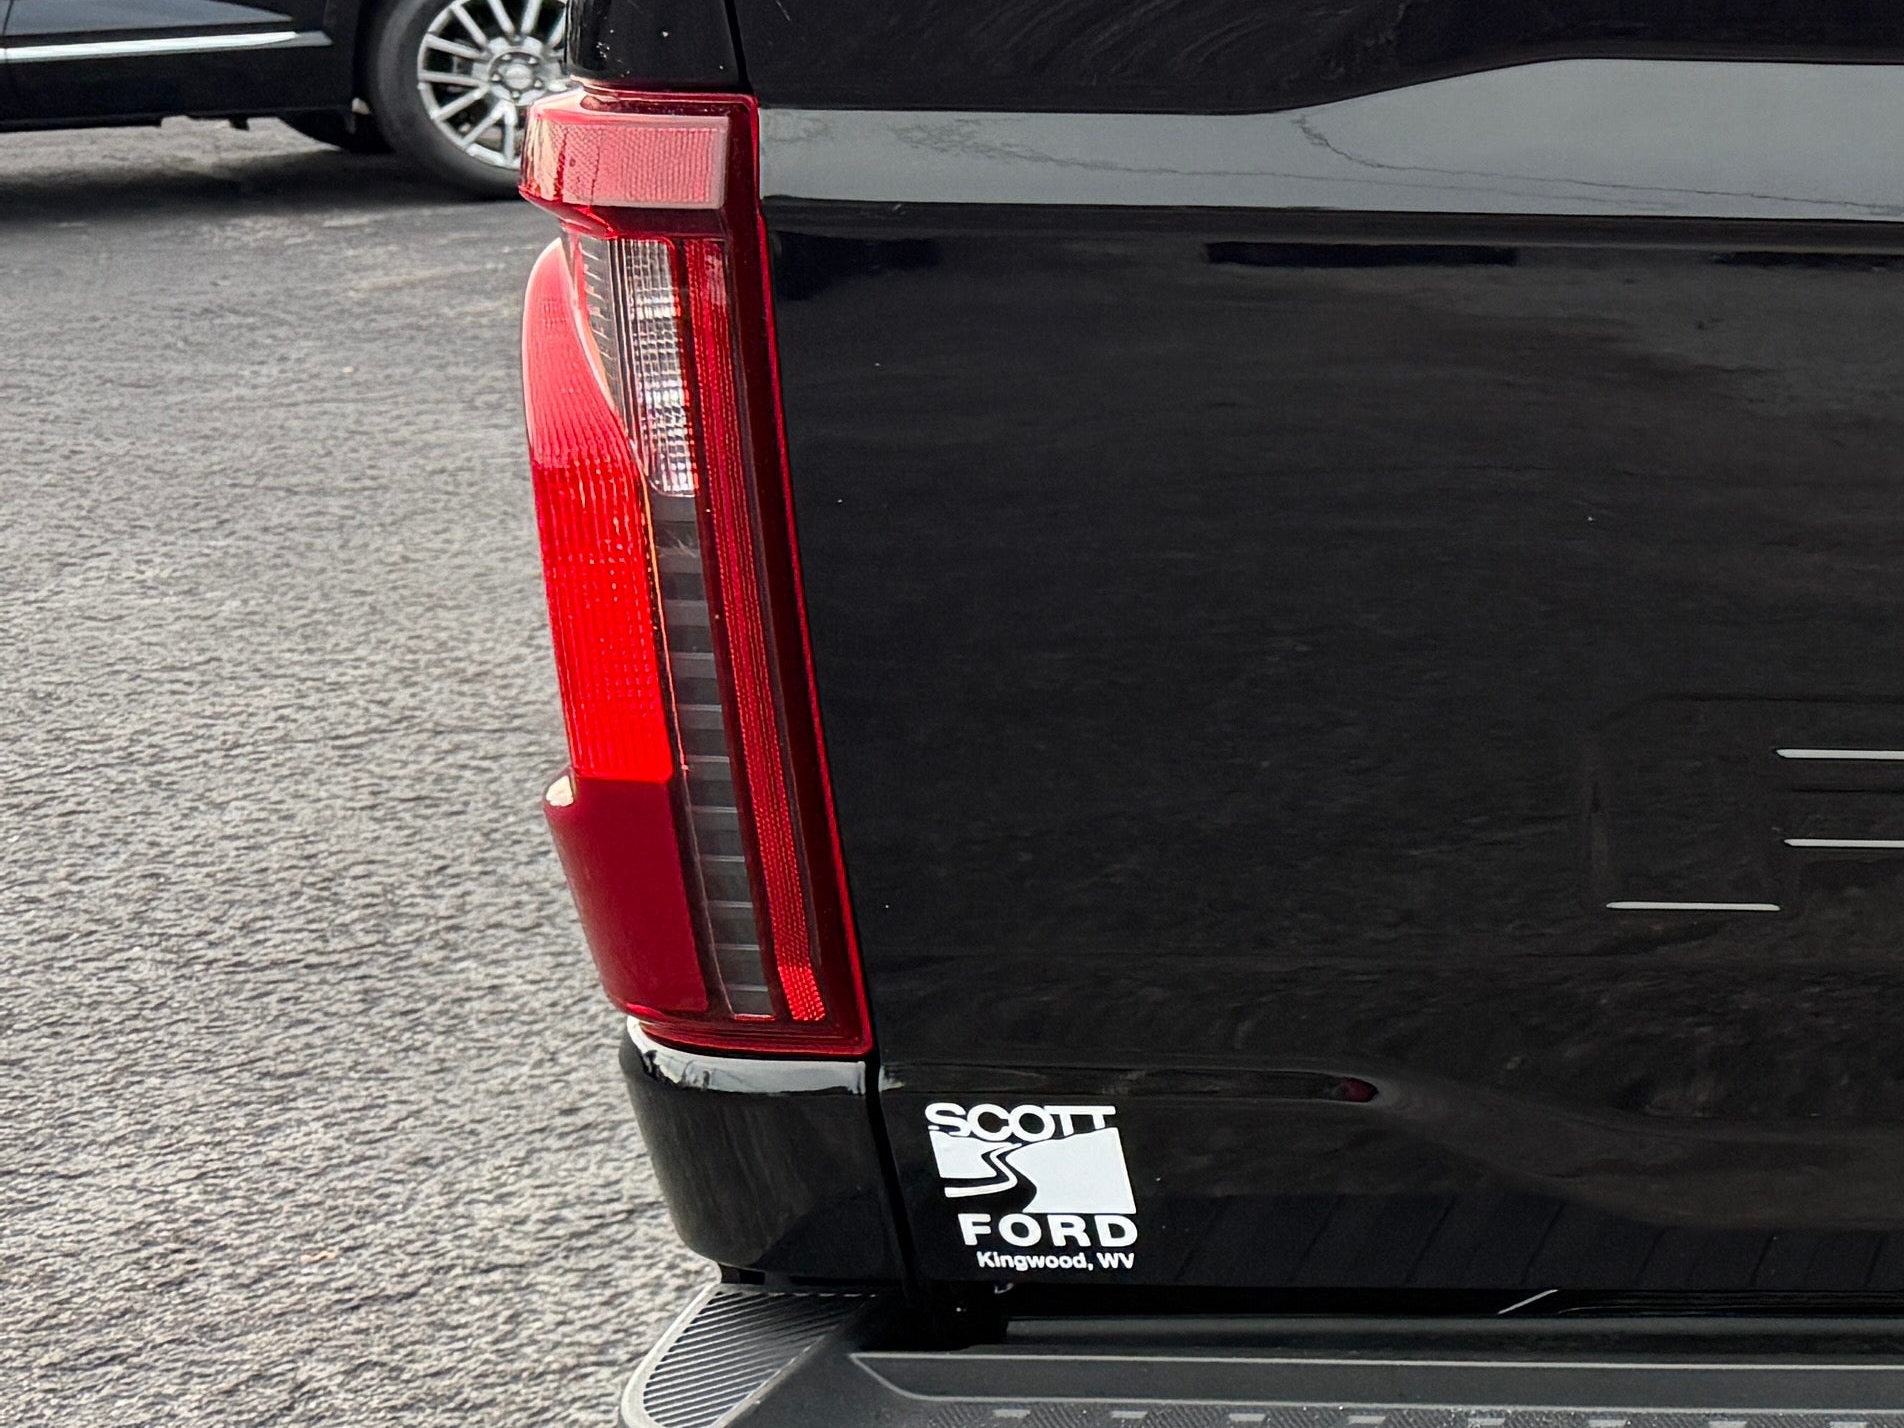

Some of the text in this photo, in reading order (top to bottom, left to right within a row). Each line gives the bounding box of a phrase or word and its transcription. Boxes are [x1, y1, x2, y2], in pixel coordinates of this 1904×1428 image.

[925, 1102, 1116, 1142] SCOTT
[957, 1213, 1138, 1247] FORD
[976, 1251, 1135, 1271] Kingwood, WV
